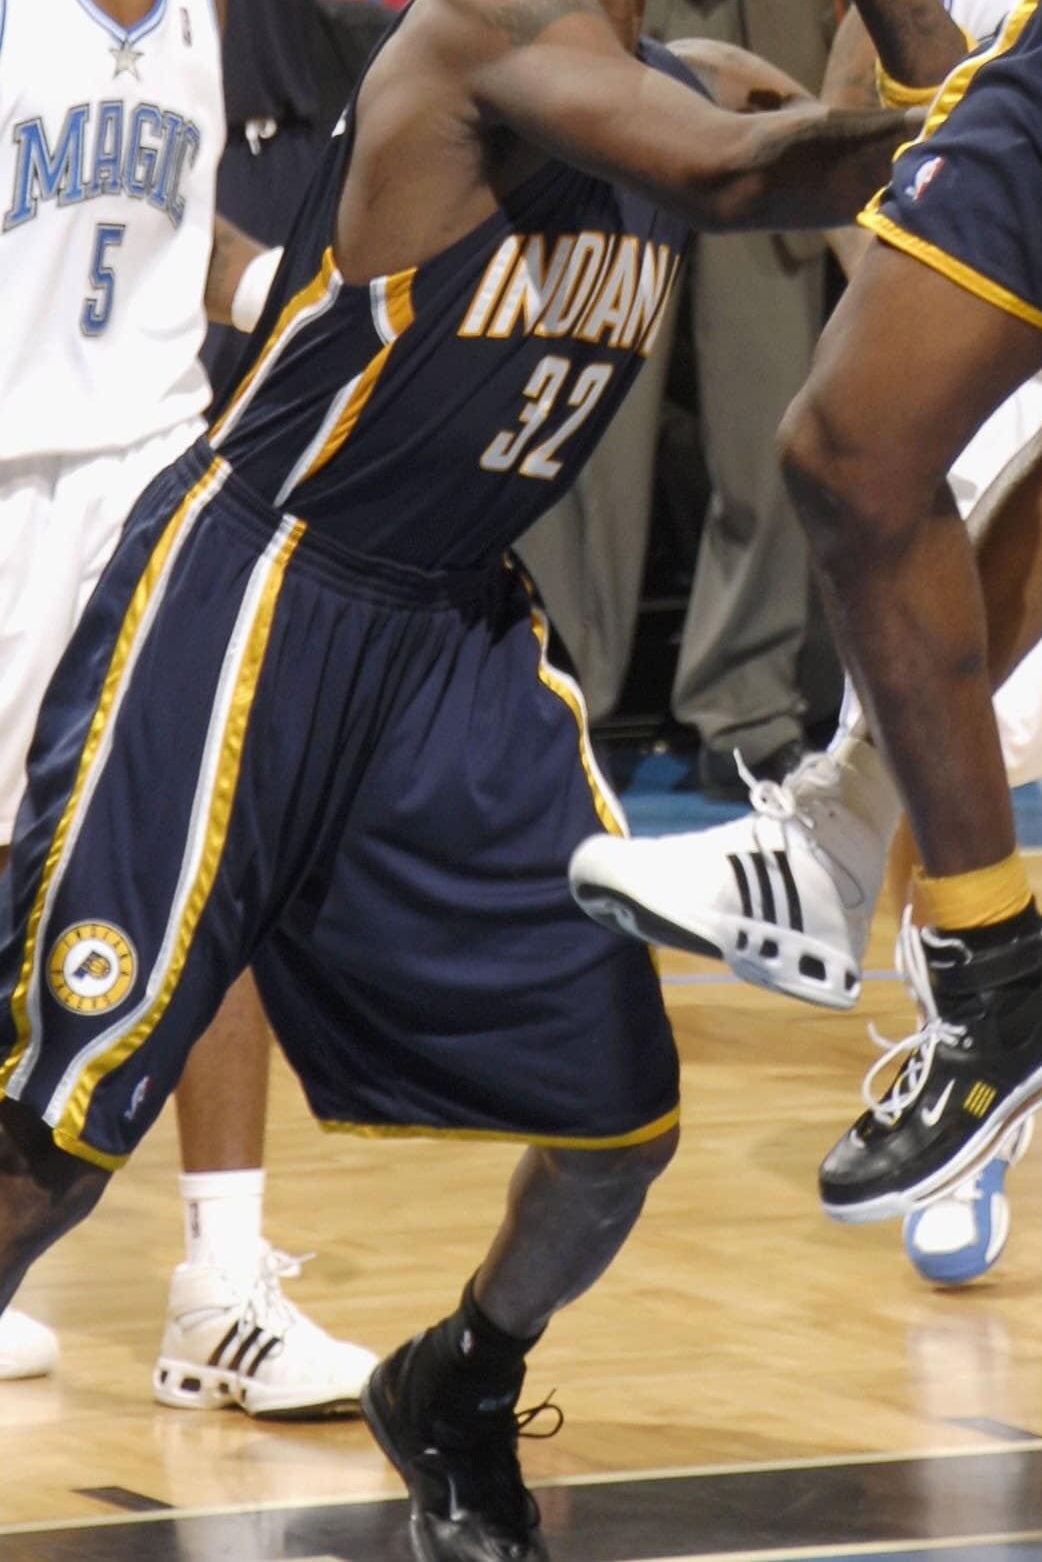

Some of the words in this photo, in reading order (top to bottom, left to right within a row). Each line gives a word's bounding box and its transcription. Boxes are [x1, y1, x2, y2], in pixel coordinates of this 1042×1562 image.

[2, 100, 201, 234] MAGIC
[80, 222, 126, 338] 5
[479, 354, 615, 481] 32
